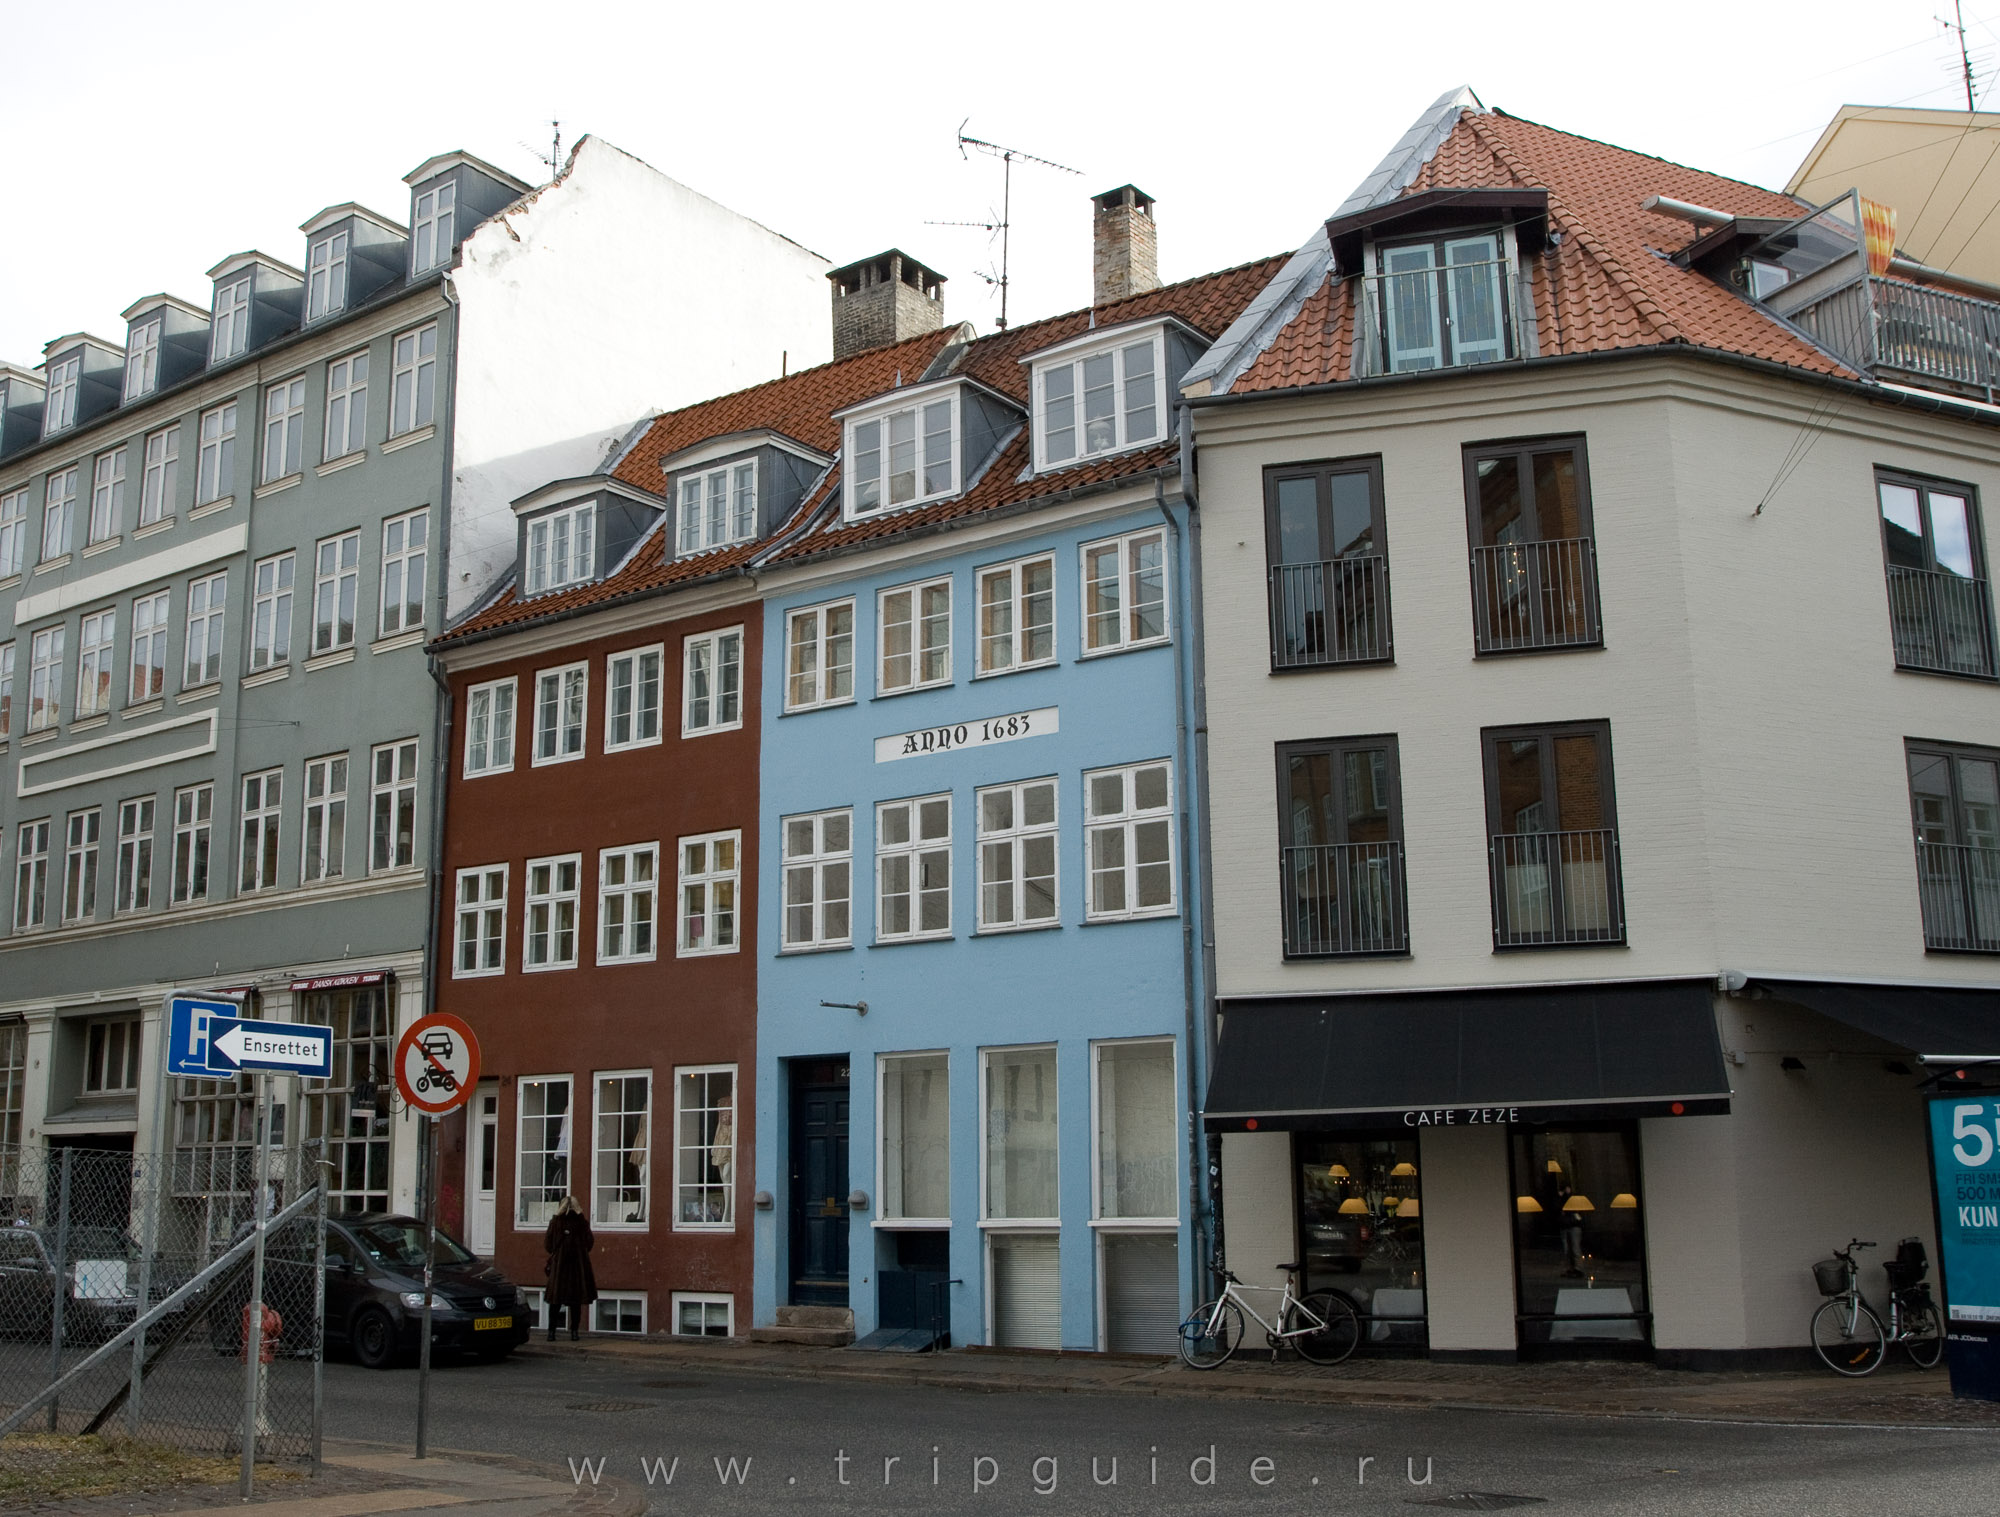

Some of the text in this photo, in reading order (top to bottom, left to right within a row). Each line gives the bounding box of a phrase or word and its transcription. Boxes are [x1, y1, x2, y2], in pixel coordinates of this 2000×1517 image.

[902, 715, 1030, 755] ANNO 1683
[312, 979, 334, 989] DANSK
[243, 1037, 318, 1057] Ensrettet
[1403, 1108, 1519, 1127] CAFE ZEZE
[1953, 1104, 1994, 1167] 5
[1956, 1173, 1976, 1185] FRI
[1957, 1186, 1986, 1201] 500
[1958, 1206, 1999, 1227] KUN
